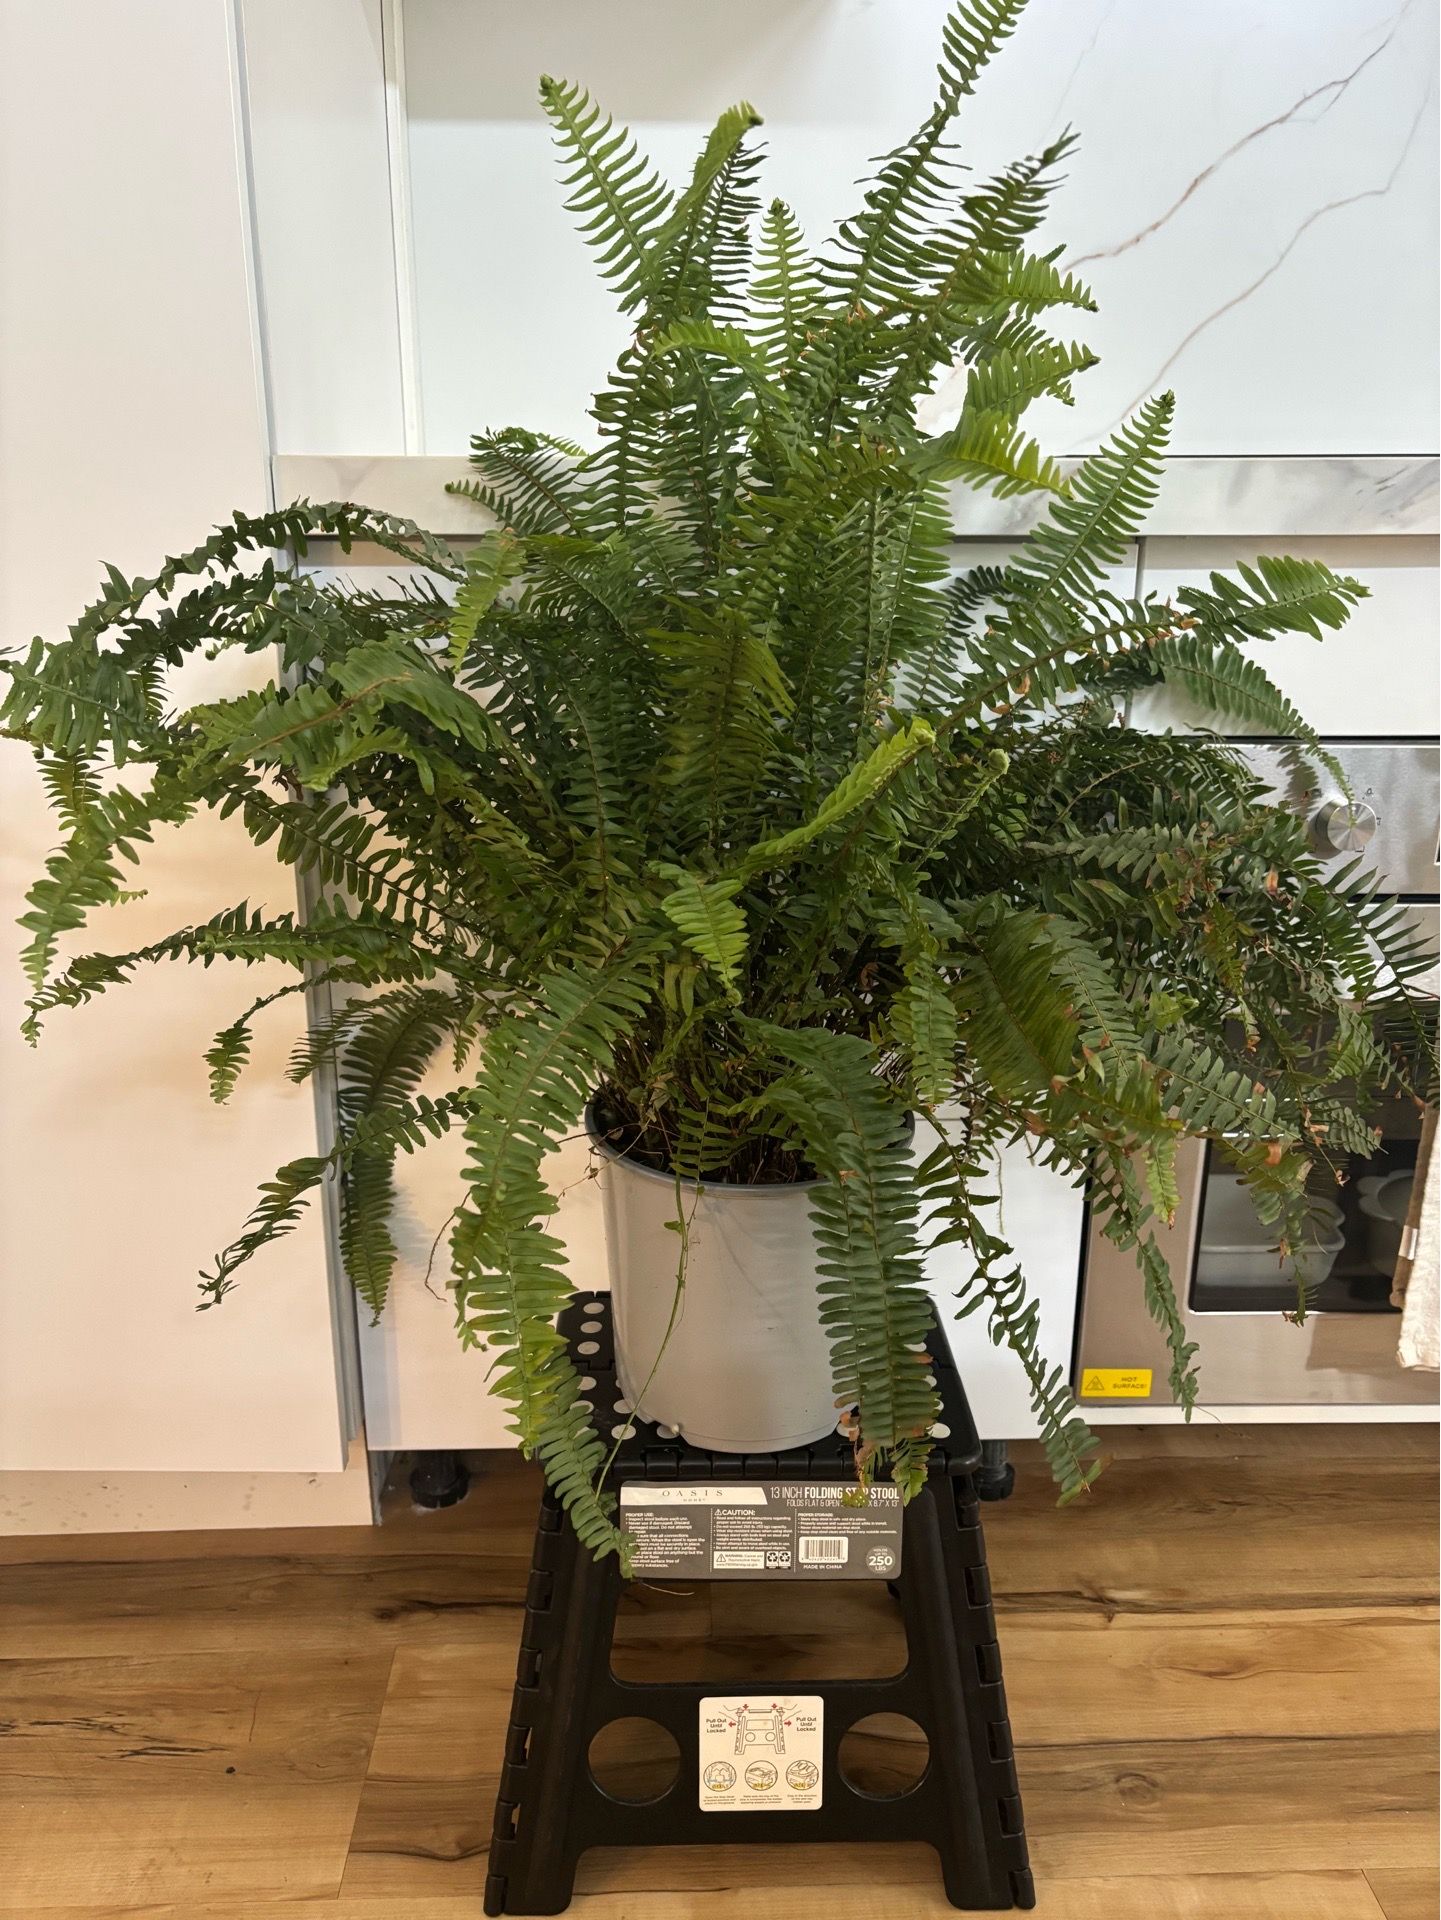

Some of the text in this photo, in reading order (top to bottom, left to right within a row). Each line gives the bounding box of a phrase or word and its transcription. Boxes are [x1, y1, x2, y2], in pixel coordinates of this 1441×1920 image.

[771, 1487, 899, 1499] 13 INCH FOLDING STP STOOL
[869, 1556, 893, 1566] 250
